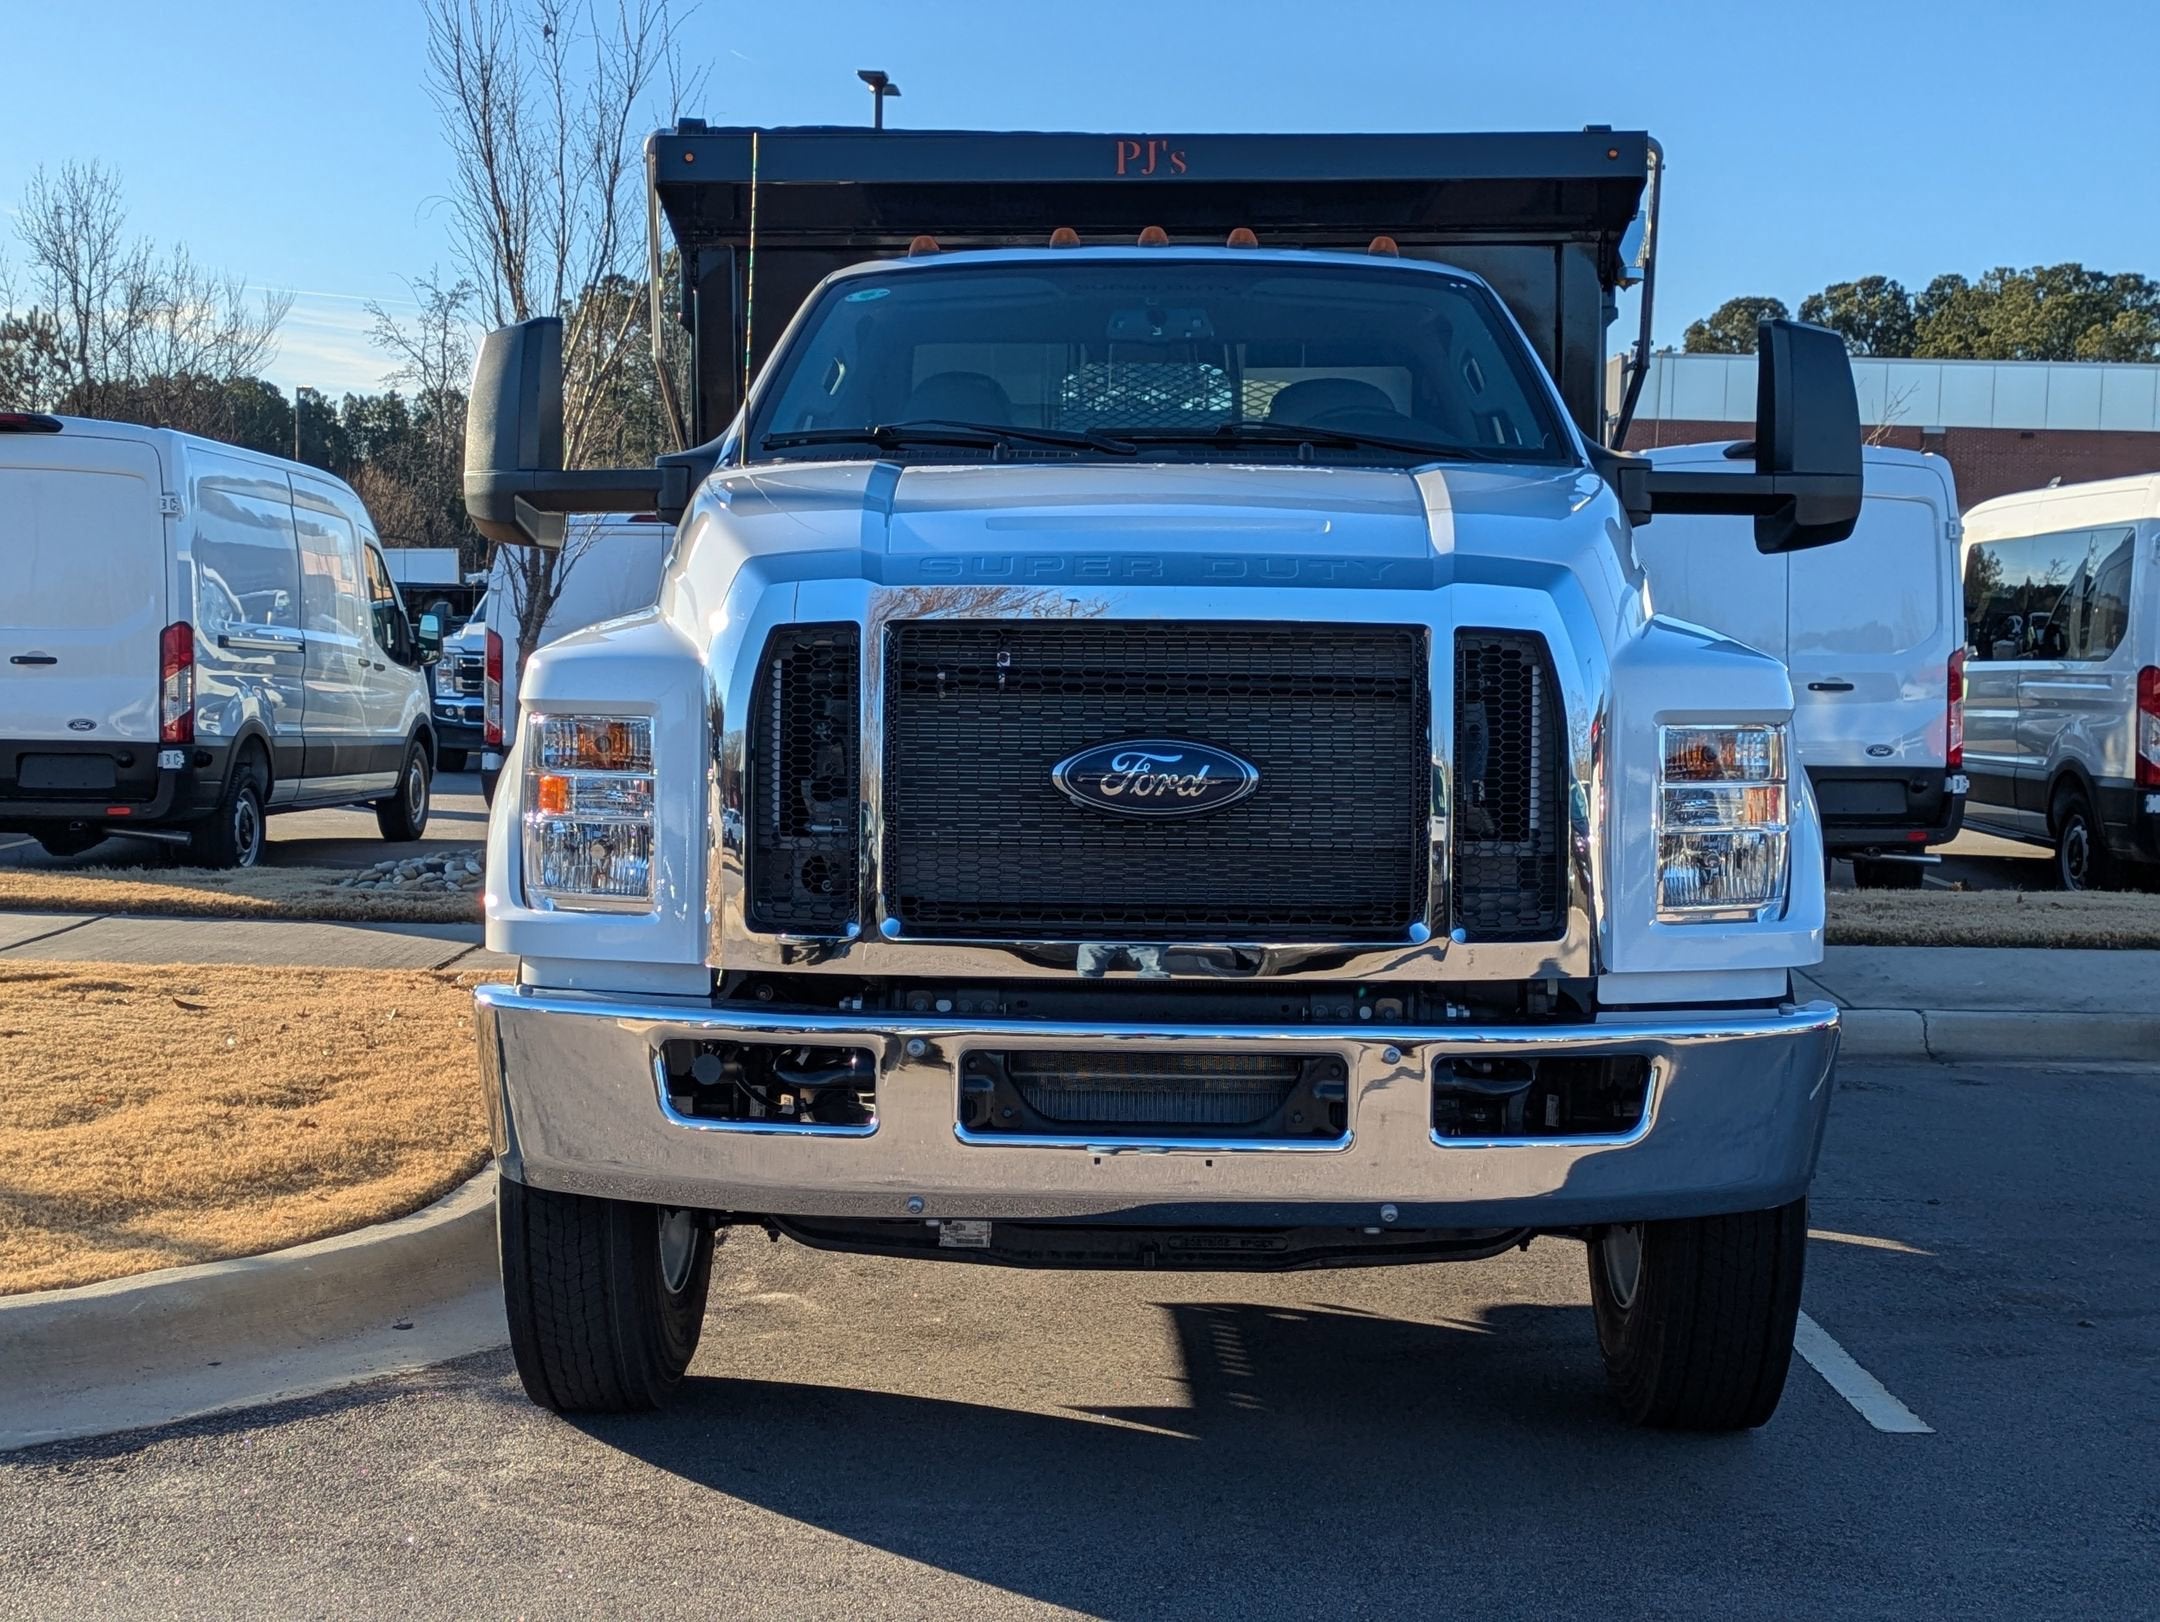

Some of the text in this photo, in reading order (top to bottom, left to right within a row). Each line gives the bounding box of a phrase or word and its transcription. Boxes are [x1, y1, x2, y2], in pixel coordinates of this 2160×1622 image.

[1116, 140, 1187, 175] PJ's
[919, 555, 1395, 582] SUPER DUTY
[1100, 751, 1212, 797] Ford
